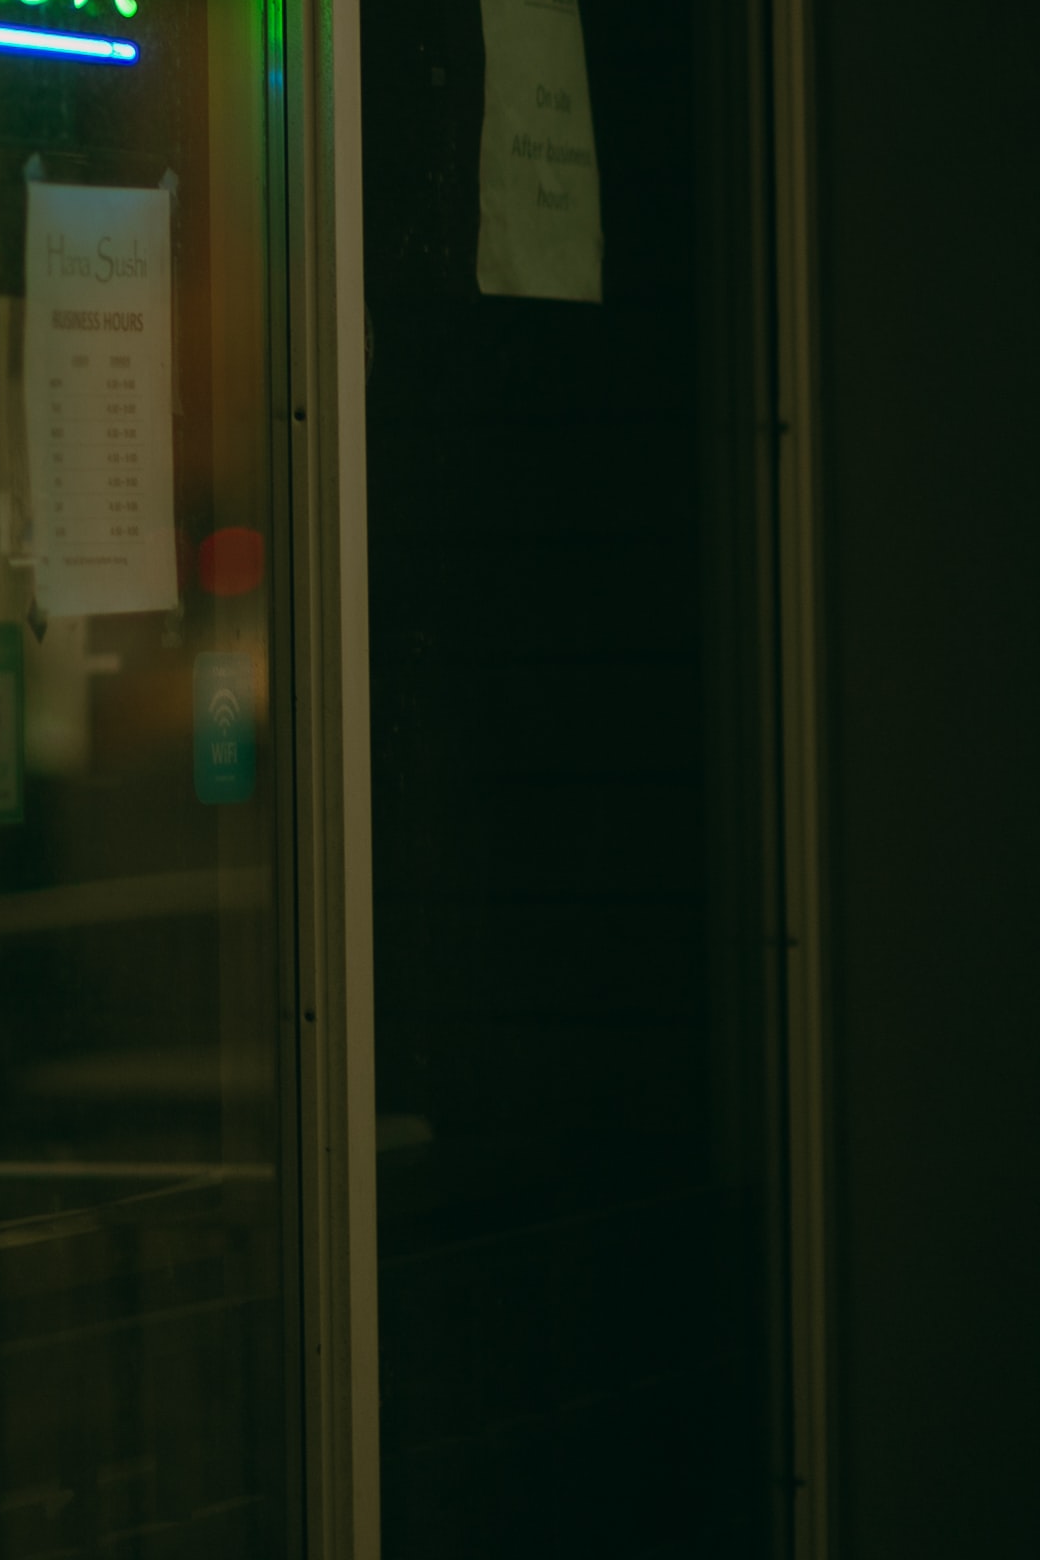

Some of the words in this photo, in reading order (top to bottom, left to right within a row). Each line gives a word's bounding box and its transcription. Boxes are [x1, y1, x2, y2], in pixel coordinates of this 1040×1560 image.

[536, 86, 552, 108] On
[511, 133, 544, 159] After
[46, 234, 91, 278] Hana
[94, 235, 148, 283] Sushi
[51, 309, 101, 332] BUSINESS
[103, 311, 144, 334] HOURS
